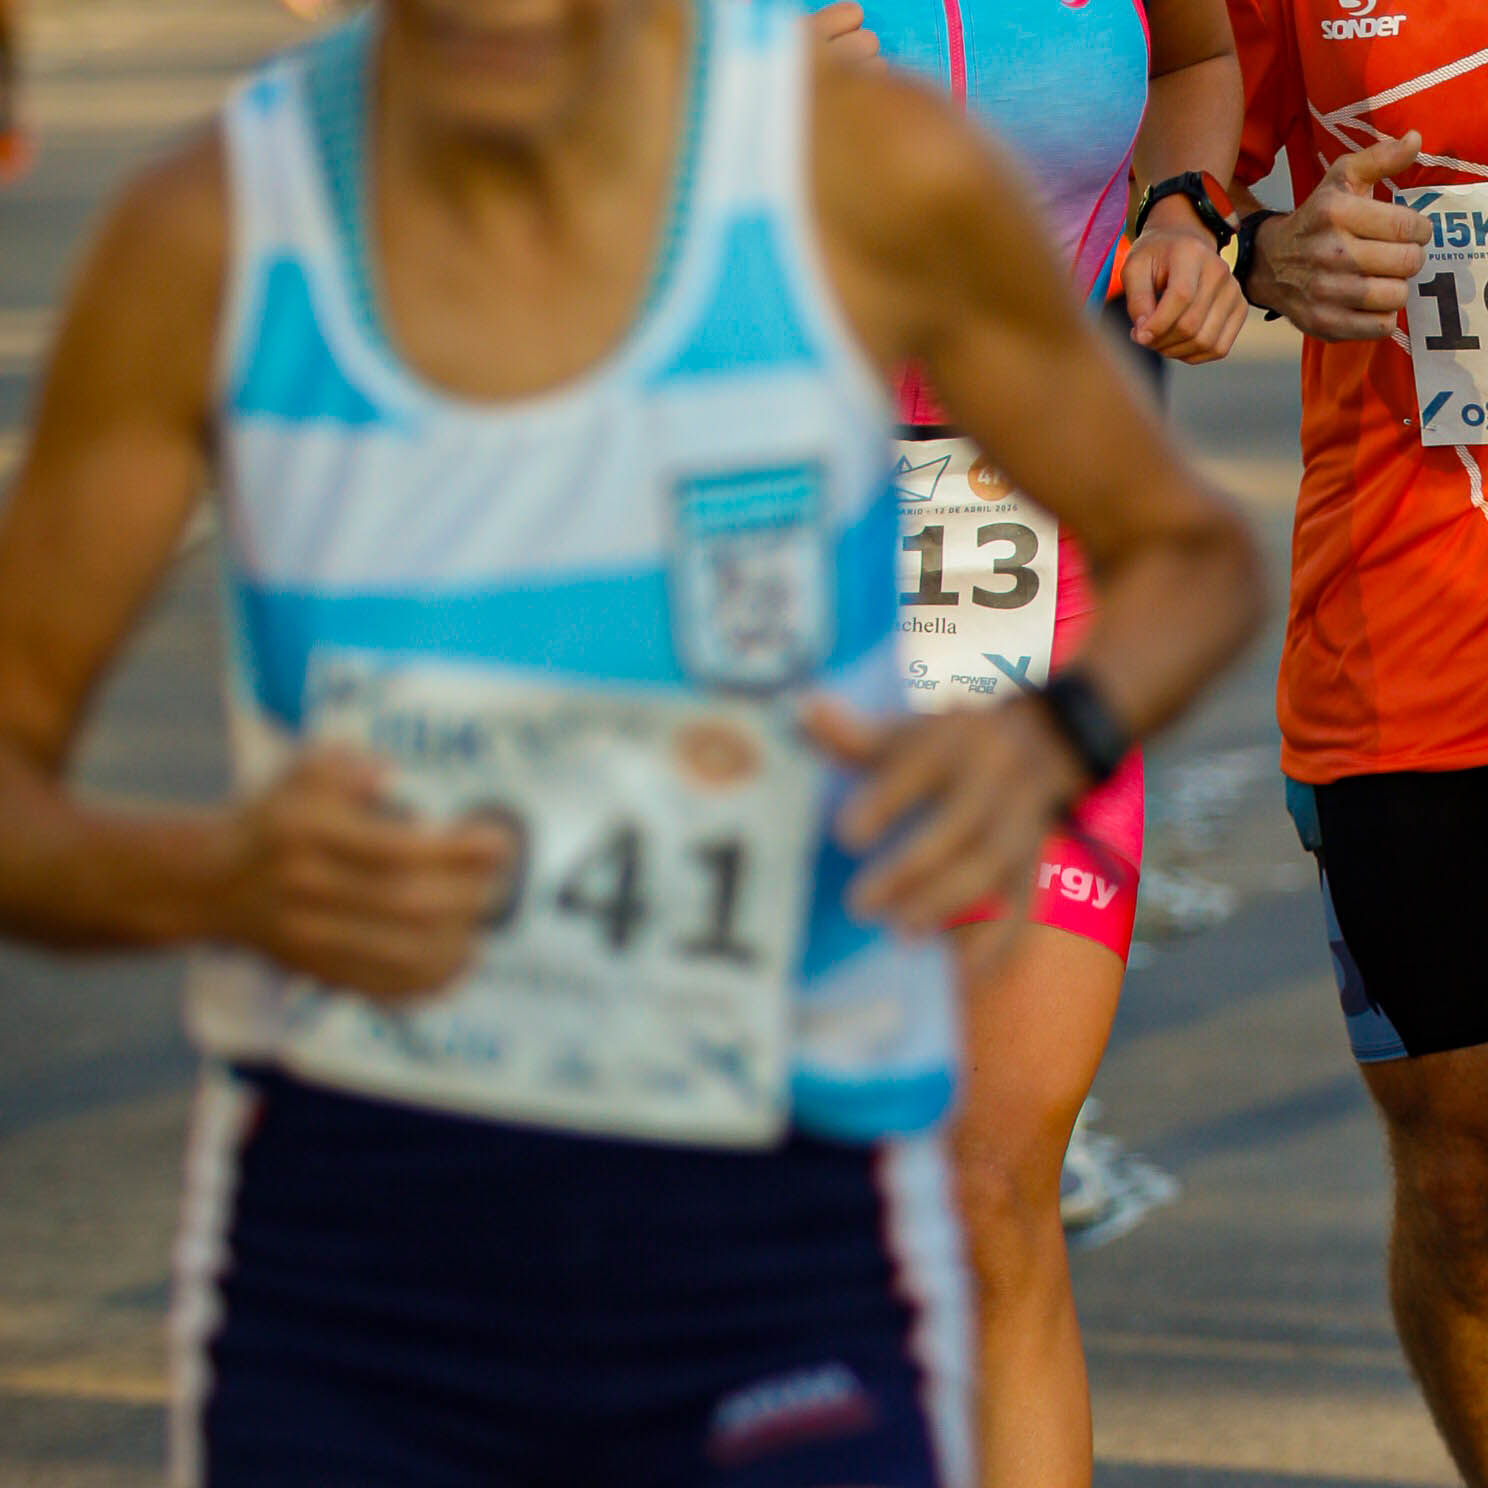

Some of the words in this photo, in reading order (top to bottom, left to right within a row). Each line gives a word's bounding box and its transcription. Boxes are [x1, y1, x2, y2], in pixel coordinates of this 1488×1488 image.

[1428, 252, 1465, 262] PUERTO
[899, 616, 957, 635] chella
[1038, 862, 1119, 910] rgy
